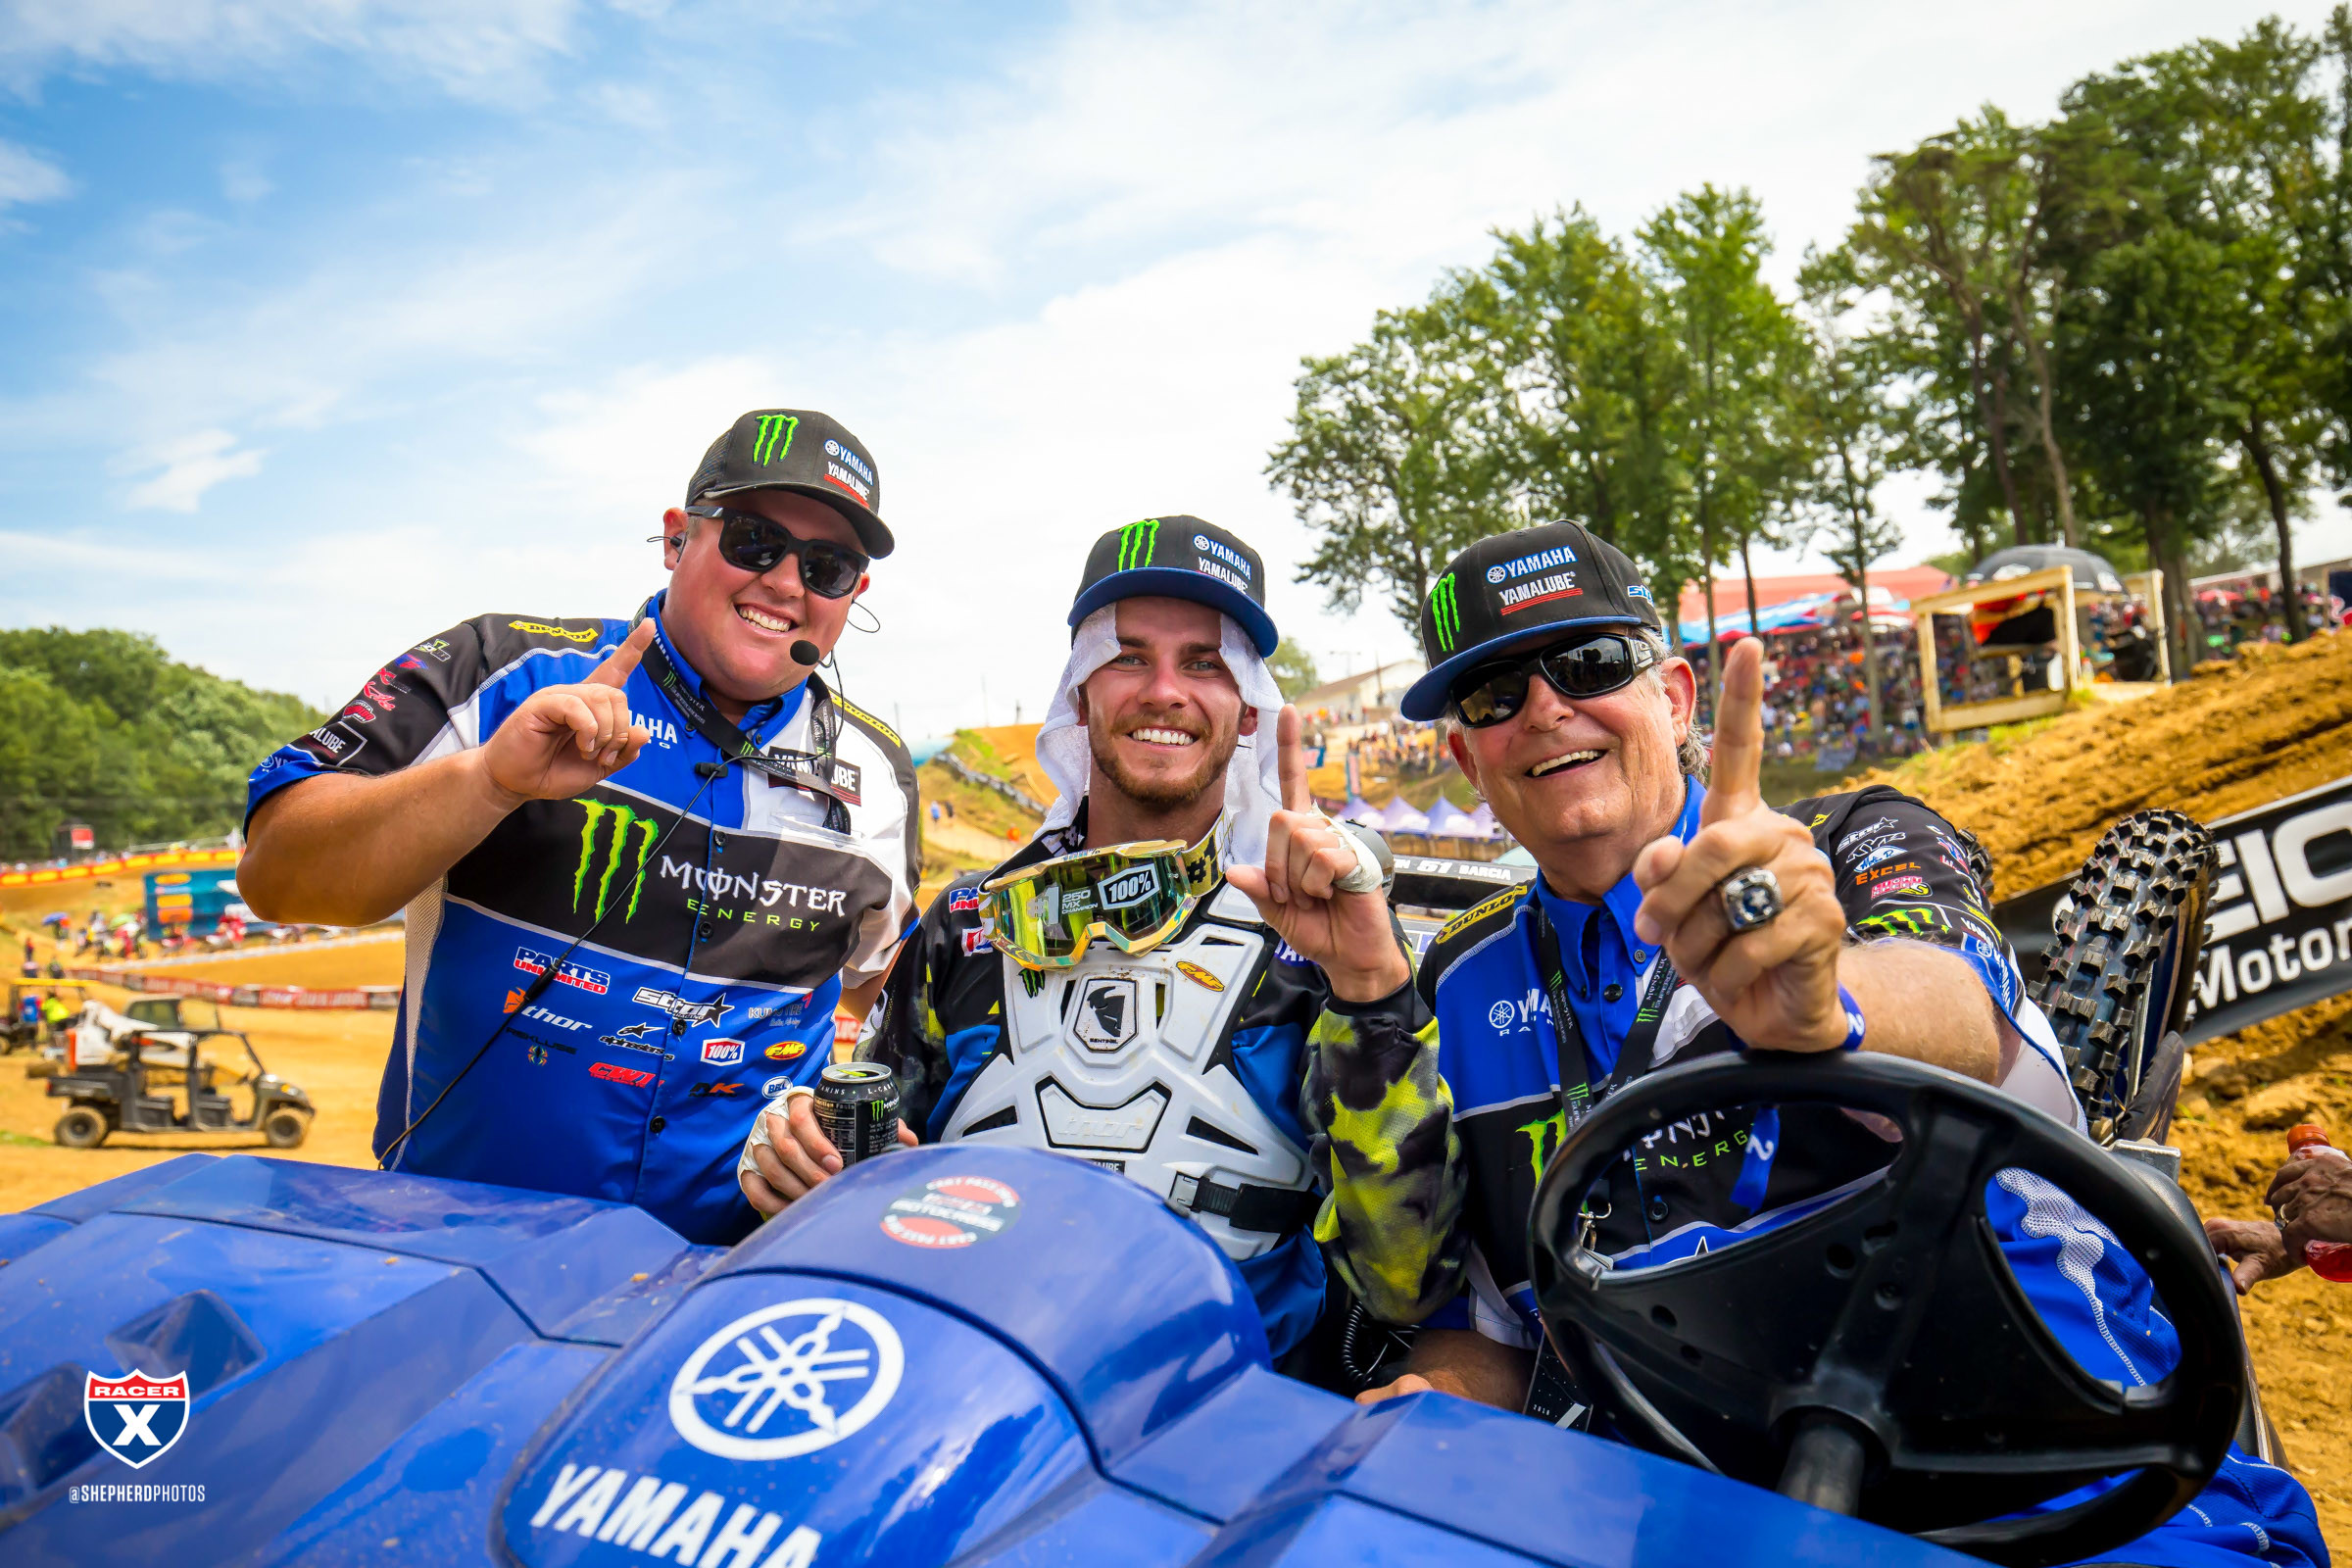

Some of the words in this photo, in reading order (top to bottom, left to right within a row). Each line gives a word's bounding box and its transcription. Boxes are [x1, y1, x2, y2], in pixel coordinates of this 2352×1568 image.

[827, 460, 870, 502] YAMALUBE
[840, 445, 874, 487] YAMAHA
[1198, 556, 1249, 596] YAMALUBE
[1210, 539, 1252, 581] YAMAHA
[1505, 545, 1578, 578] YAMAHA
[1499, 571, 1575, 607] YAMALUBE
[528, 623, 592, 640] DUNLOP
[627, 709, 678, 745] AHA
[1417, 859, 1453, 874] 51
[1855, 861, 1922, 886] EXCEL
[660, 855, 848, 917] MONSTER
[1061, 889, 1091, 903] 250
[1108, 870, 1152, 904] 100%
[1061, 900, 1081, 910] MX
[1061, 903, 1099, 915] CHAMPION
[516, 946, 611, 987] PARTS
[520, 1005, 593, 1031] thor
[506, 1026, 578, 1055] REKLUSE
[707, 1044, 740, 1061] 100%
[765, 1043, 805, 1057] FMF
[1634, 1129, 1749, 1171] ENERG
[530, 1463, 822, 1568] YAMAHA
